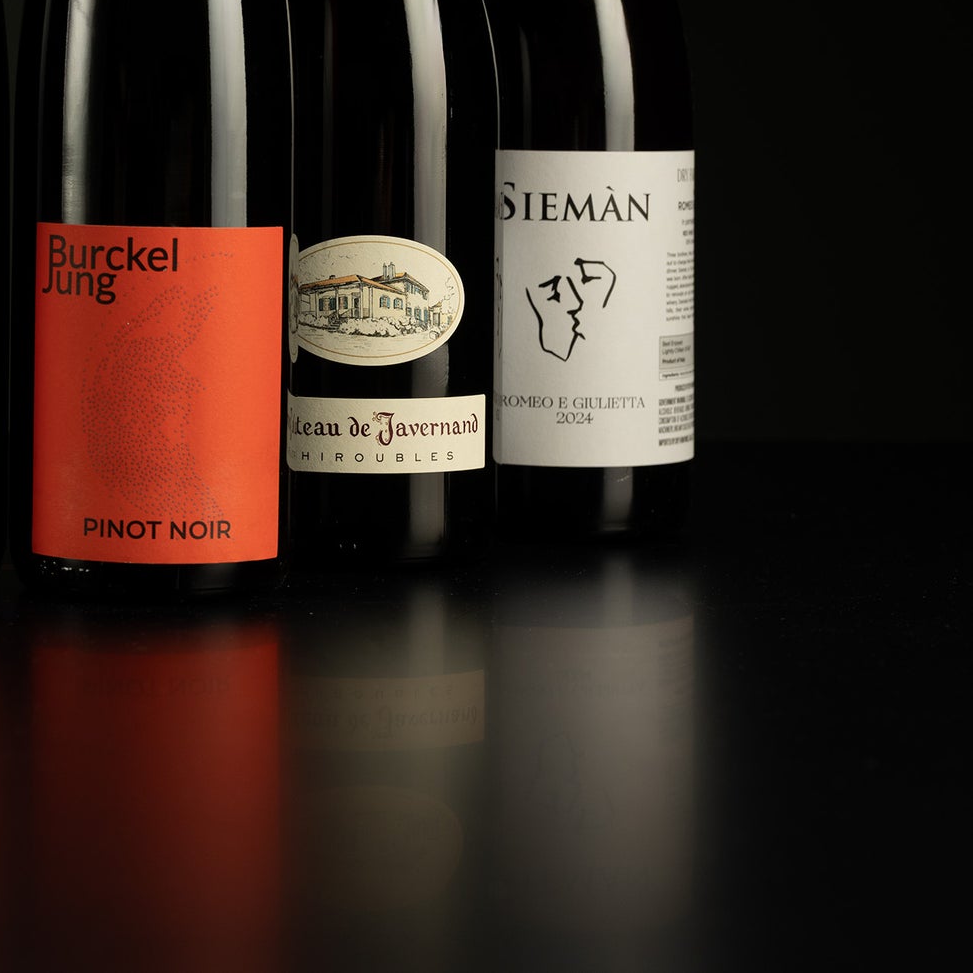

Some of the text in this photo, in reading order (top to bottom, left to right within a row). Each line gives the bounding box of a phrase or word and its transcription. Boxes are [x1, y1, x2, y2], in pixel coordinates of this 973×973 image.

[500, 181, 651, 222] SIEMÀN
[49, 234, 179, 272] Burckel
[42, 269, 117, 305] Jung
[500, 395, 646, 410] ROMEO E GIULIETTA
[292, 411, 479, 447] teau de Javernand
[556, 411, 594, 424] 2024
[300, 451, 454, 463] HIROUBLES
[82, 518, 232, 540] PINOT NOIR
